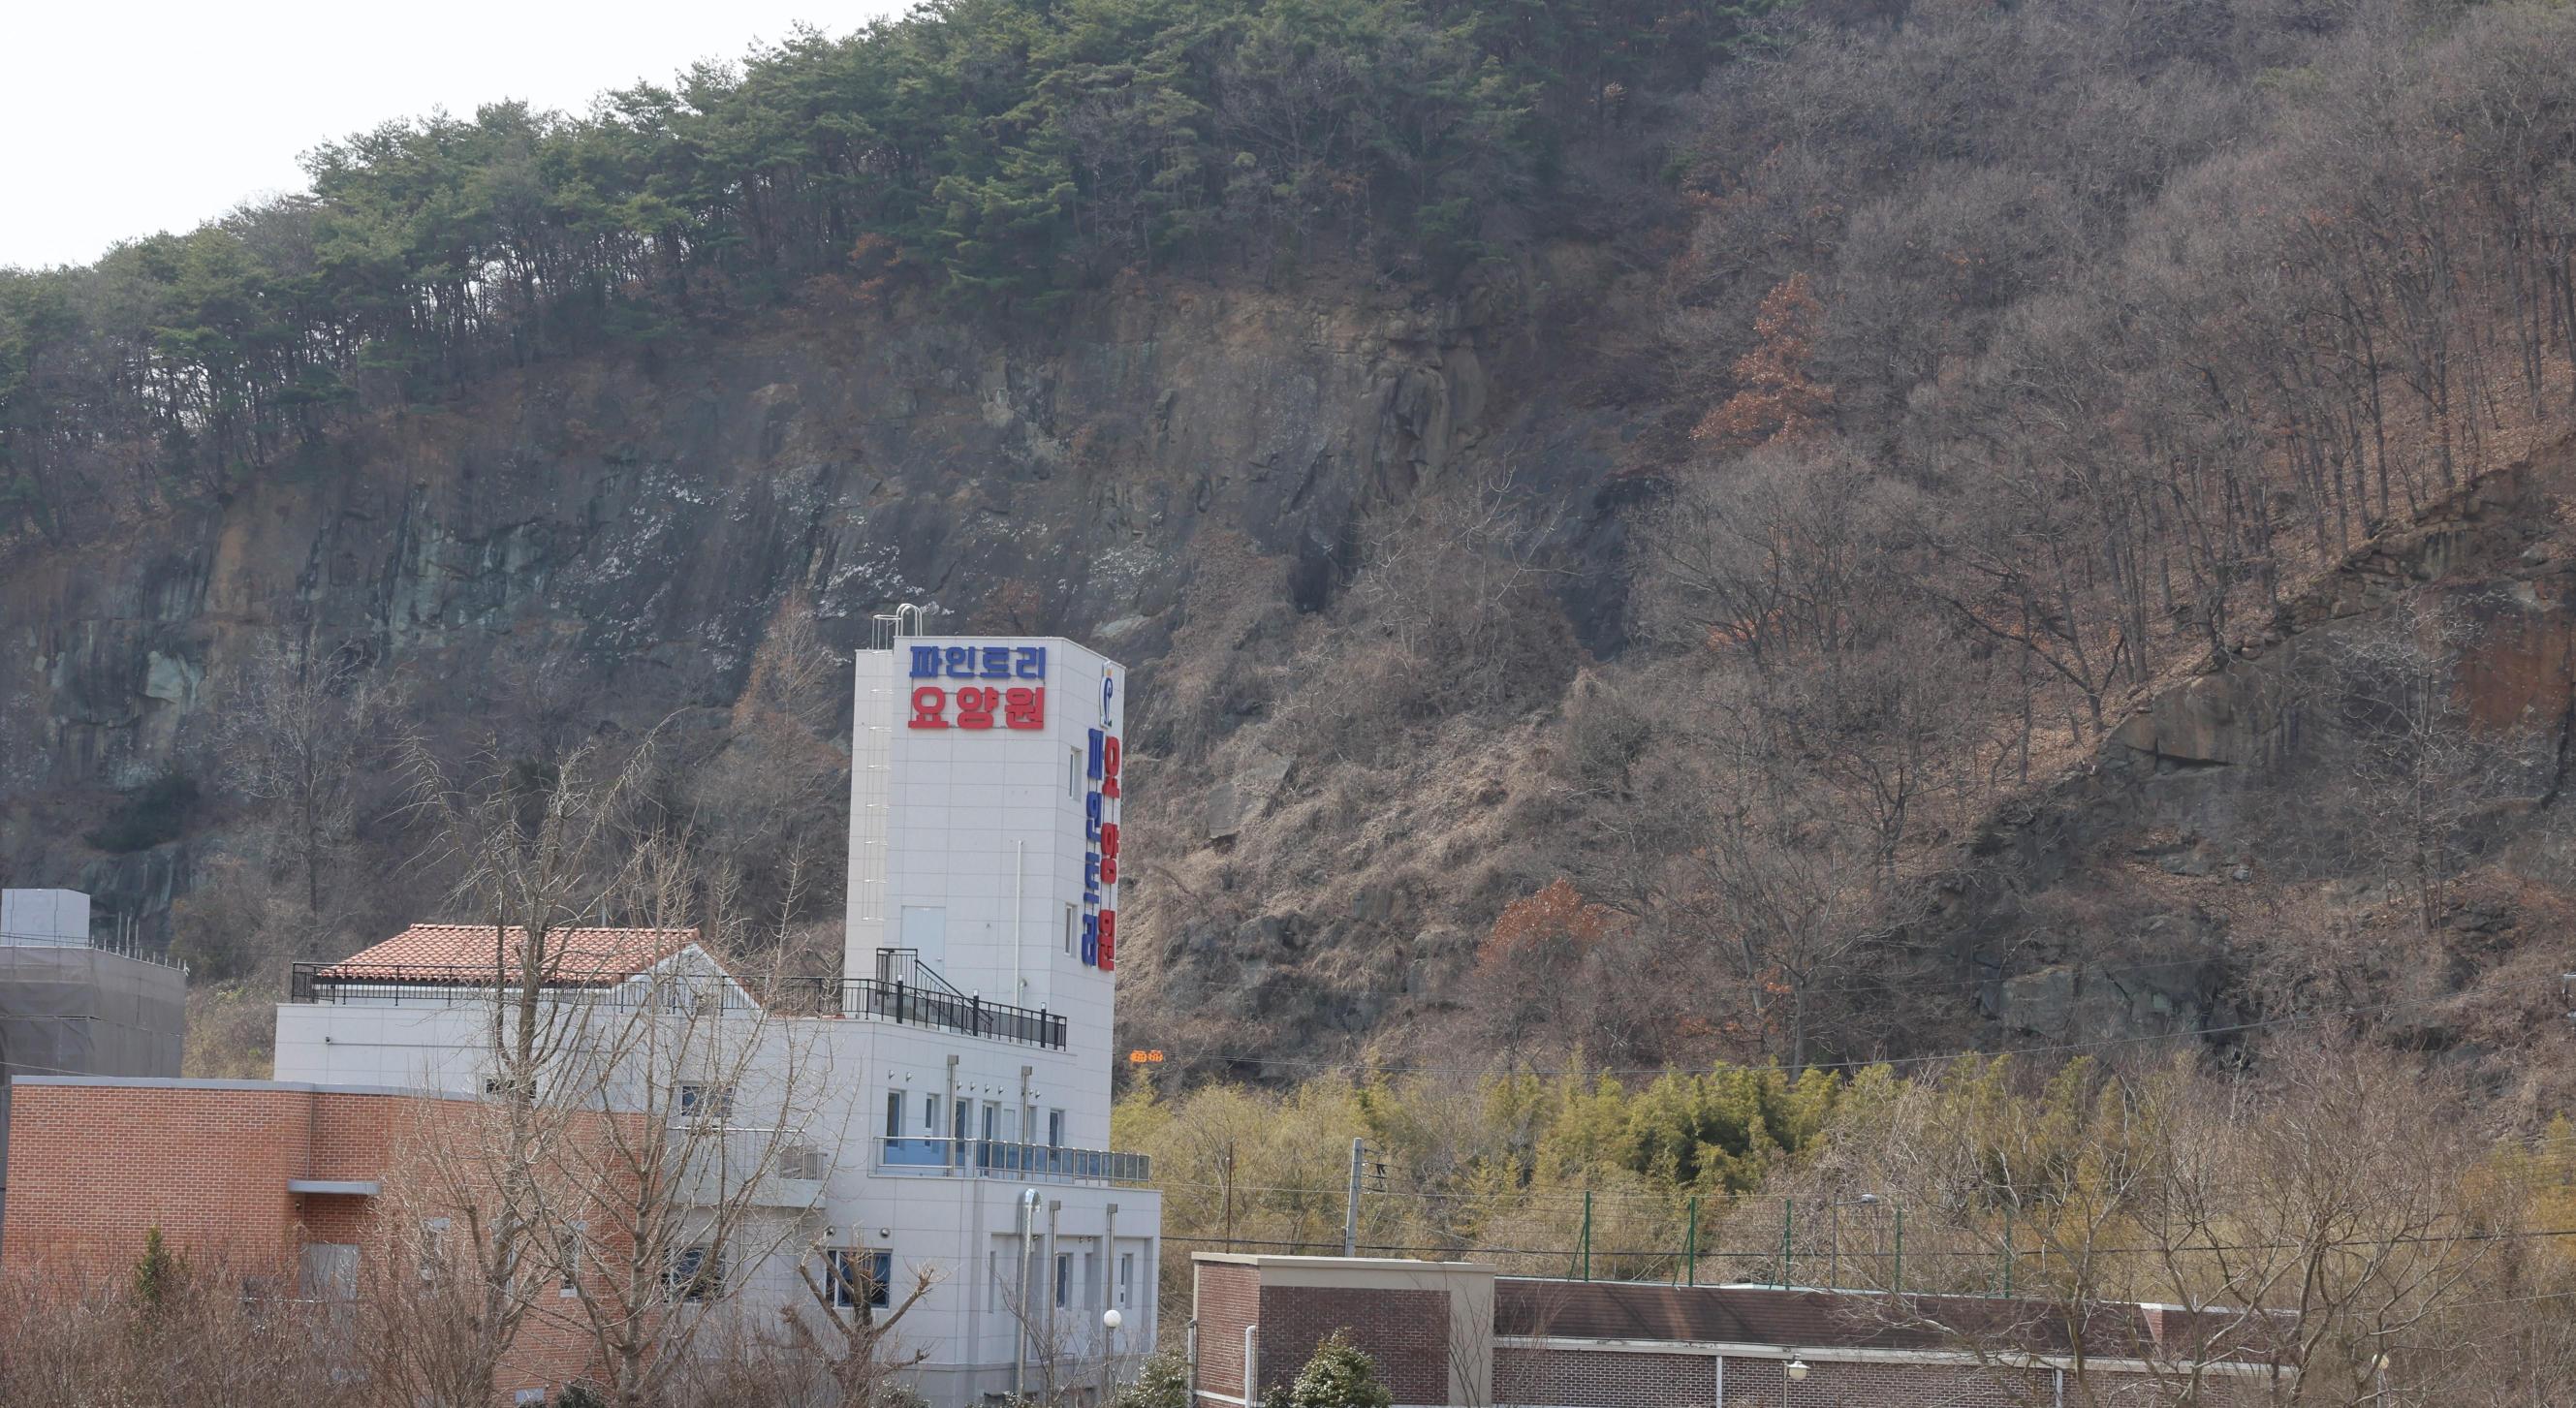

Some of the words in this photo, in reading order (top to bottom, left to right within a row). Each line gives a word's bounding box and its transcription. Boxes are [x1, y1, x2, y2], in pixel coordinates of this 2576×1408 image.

[908, 686, 1045, 729] 요양원
[910, 646, 1046, 678] 파인트리
[1082, 728, 1104, 967] 파인트리
[1098, 735, 1119, 971] 요양원
